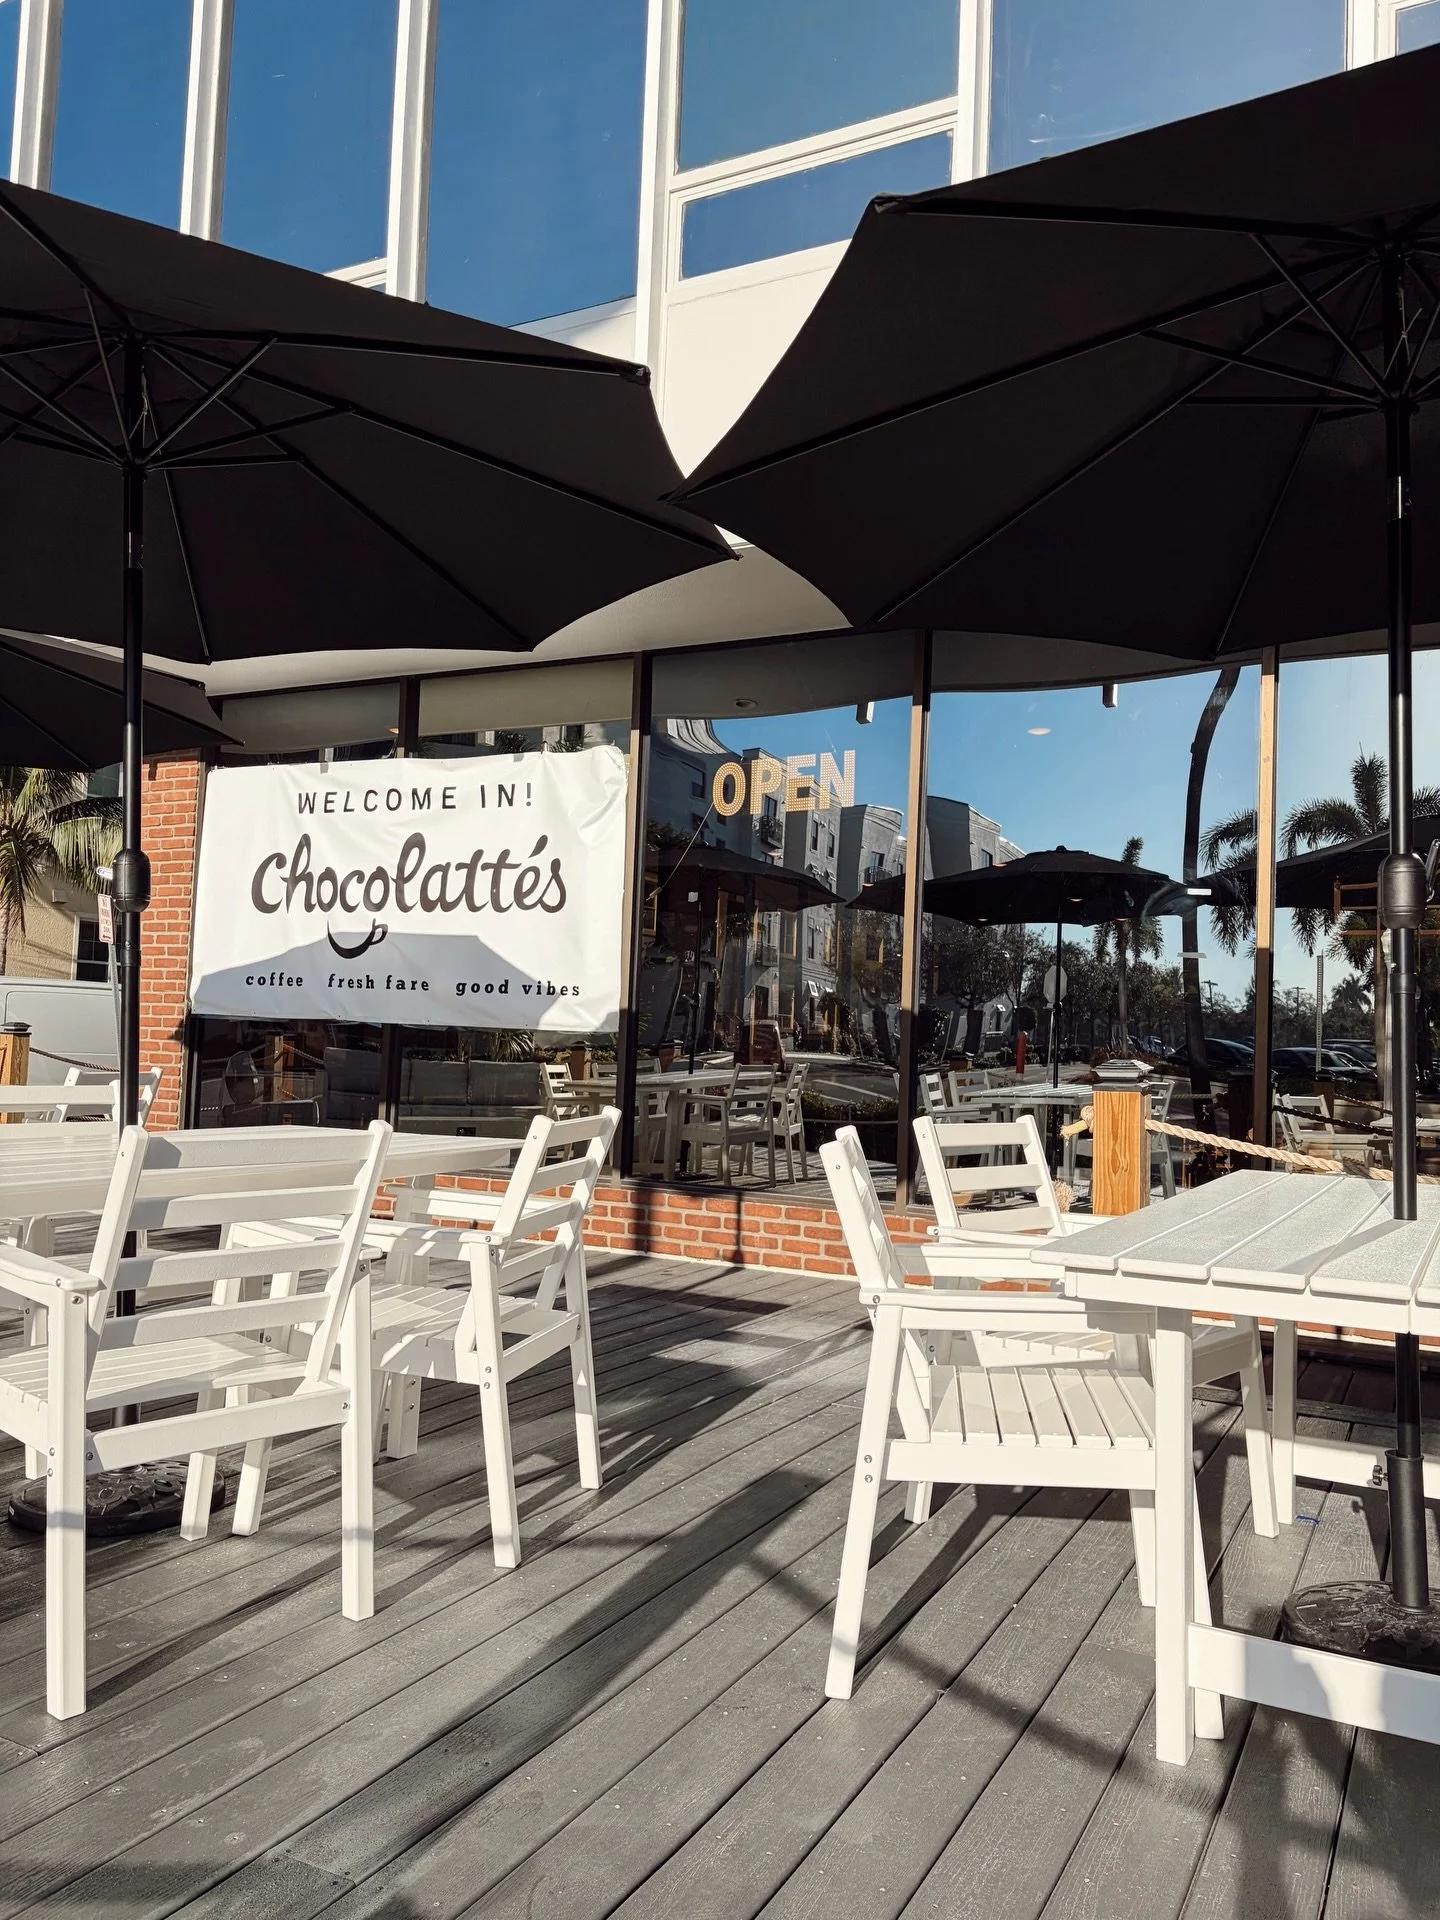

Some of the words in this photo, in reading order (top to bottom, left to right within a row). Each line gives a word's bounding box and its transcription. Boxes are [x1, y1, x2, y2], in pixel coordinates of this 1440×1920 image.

[298, 785, 457, 815] WELCOME
[480, 782, 533, 809] IN!
[712, 750, 856, 816] OPEN
[245, 971, 304, 987] coffee
[327, 973, 375, 989] fresh
[385, 974, 430, 990] fare
[455, 979, 509, 997] good
[521, 980, 580, 996] vibes
